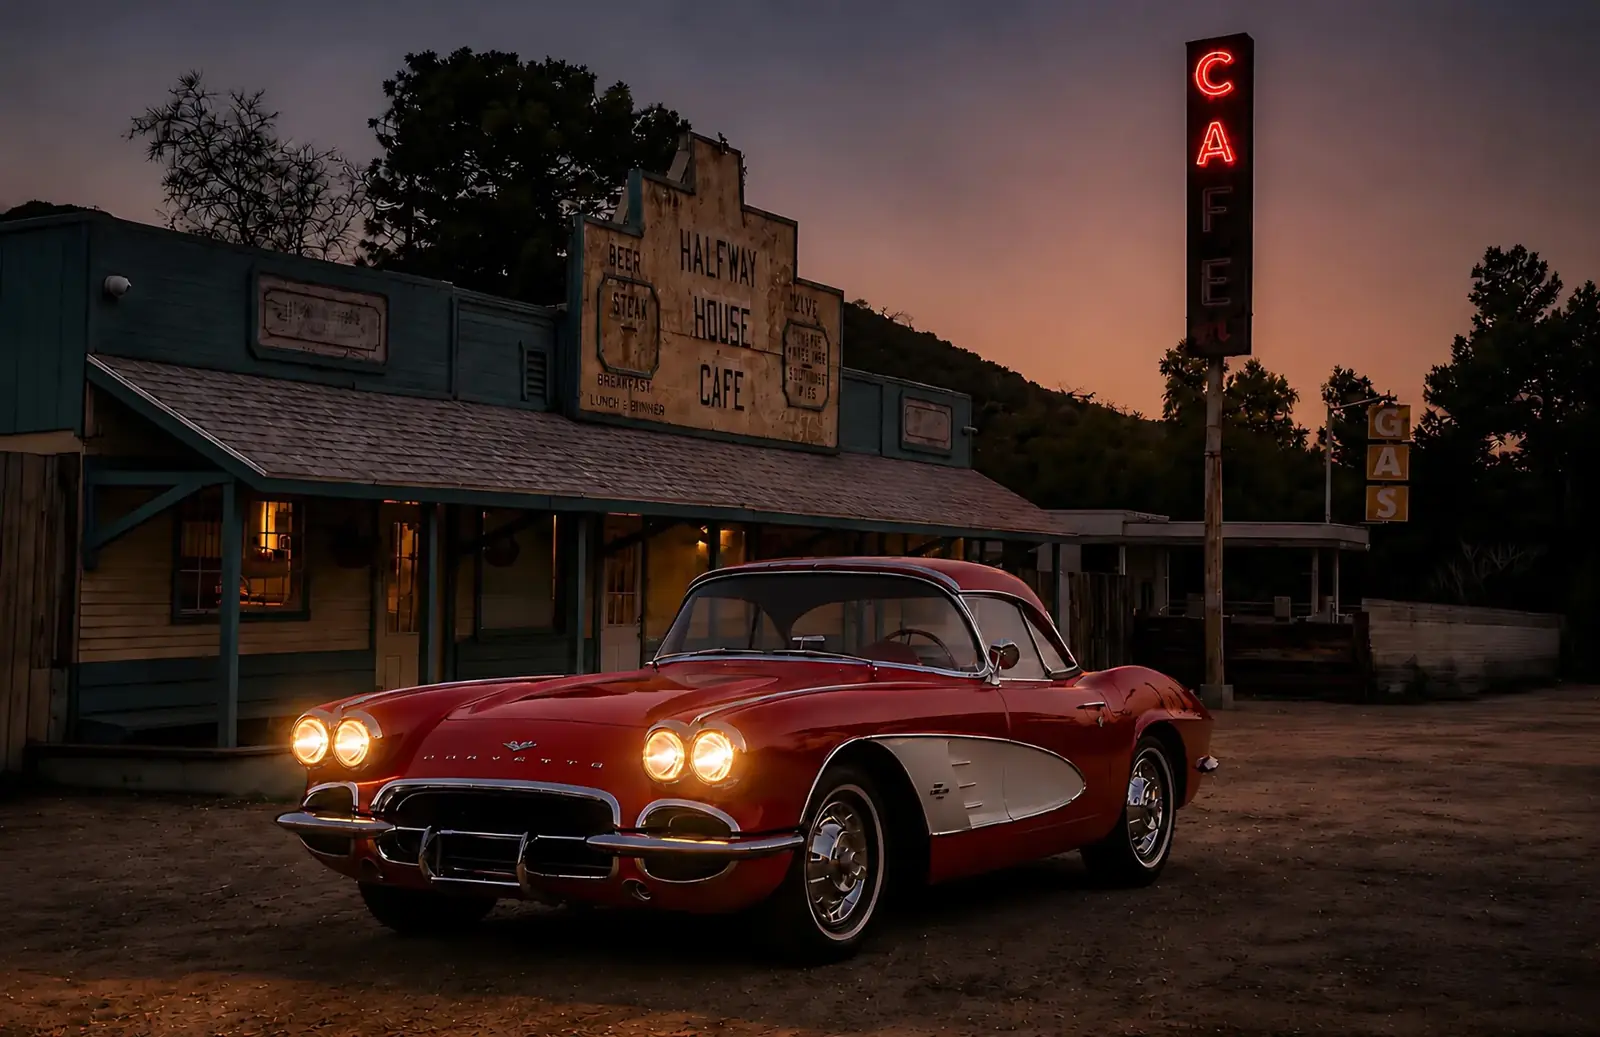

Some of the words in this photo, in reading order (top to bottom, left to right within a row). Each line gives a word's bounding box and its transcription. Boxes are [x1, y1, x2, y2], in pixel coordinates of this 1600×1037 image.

[1195, 51, 1235, 306] CAFE
[609, 243, 641, 275] BEER
[680, 228, 757, 287] HALFWAY
[694, 295, 751, 349] HOUSE
[590, 394, 620, 409] LUNCH
[700, 363, 745, 411] CAFE
[1373, 408, 1403, 518] GAS
